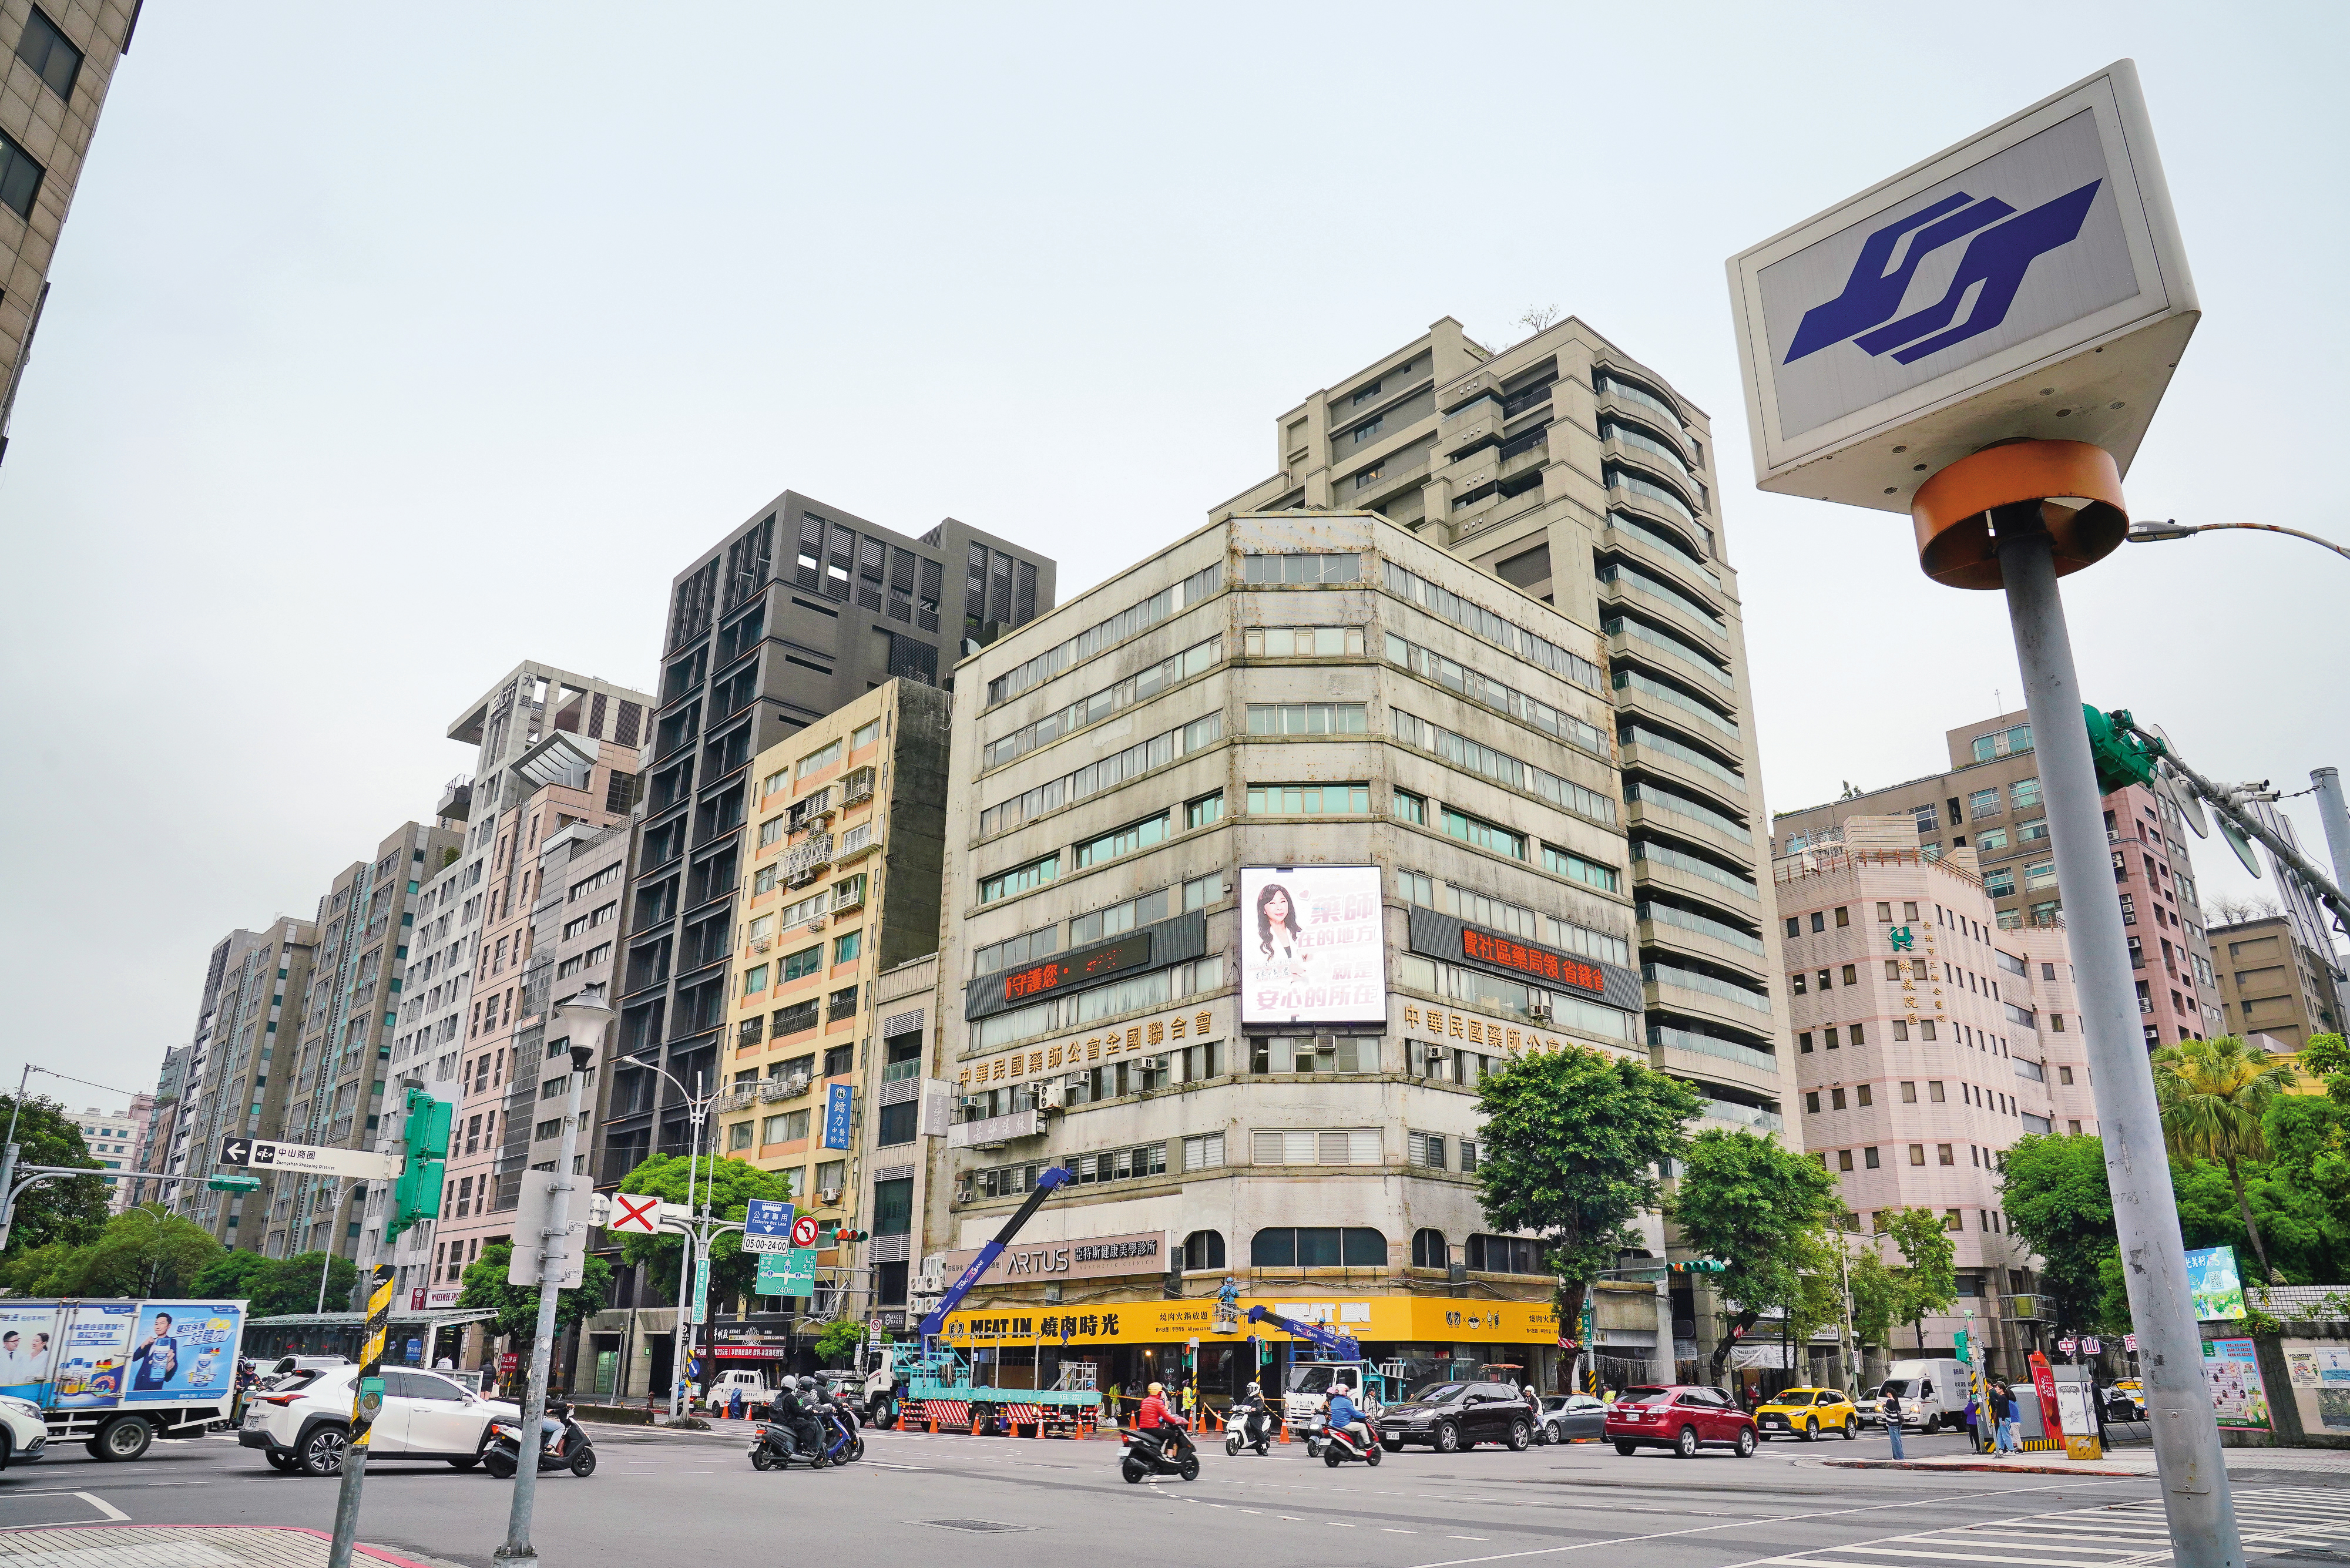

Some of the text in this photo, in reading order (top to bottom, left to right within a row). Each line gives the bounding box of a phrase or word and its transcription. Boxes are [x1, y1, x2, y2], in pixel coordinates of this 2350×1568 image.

[1311, 892, 1375, 924] 藥師
[1298, 926, 1375, 948] 在的地方
[1332, 961, 1374, 980] 就是
[1257, 984, 1375, 1010] 安心的所在
[1898, 960, 1919, 1025] 林森院區
[960, 1010, 1212, 1087] 中華民國藥師公會全國聯合會
[278, 1148, 315, 1160] 中山商圈
[753, 1211, 788, 1221] 公車專用
[746, 1238, 786, 1251] 05:00~24:00
[1075, 1240, 1157, 1261] 亞特斯健康美學診所
[971, 1260, 984, 1274] CRANE
[1006, 1248, 1069, 1275] ARTUS
[697, 1264, 706, 1300] 民權東路一段
[776, 1286, 794, 1294] 240m
[431, 1292, 451, 1301] WINESWEE
[1040, 1313, 1119, 1337] 燒肉時光
[1160, 1311, 1208, 1321] 燒肉火鍋放題
[971, 1318, 1032, 1339] MEAT IN
[1307, 1330, 1318, 1338] CRANE
